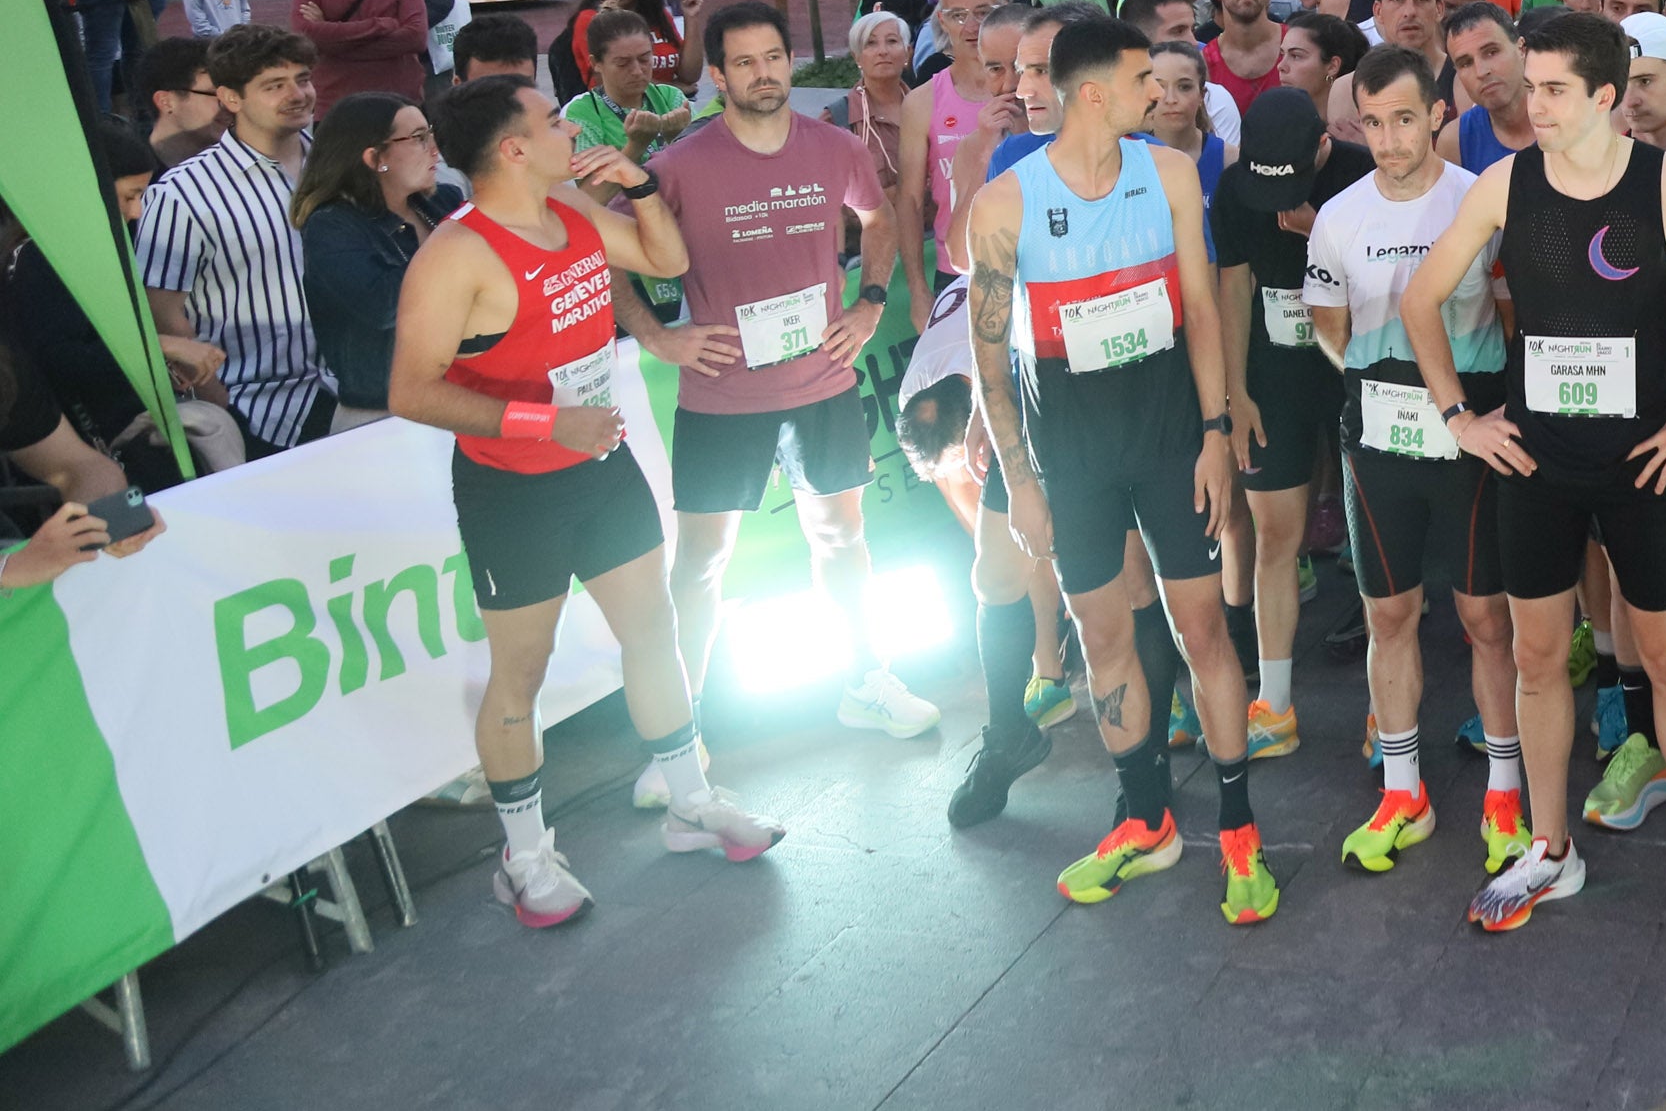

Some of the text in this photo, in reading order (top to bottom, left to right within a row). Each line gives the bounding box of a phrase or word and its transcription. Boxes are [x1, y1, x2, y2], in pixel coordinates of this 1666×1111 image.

[1250, 161, 1294, 177] HOKA
[725, 194, 826, 216] media maratón
[725, 214, 752, 222] Bidasoa
[742, 226, 773, 237] LOMEÑA
[740, 305, 756, 319] 10K
[1064, 305, 1083, 319] 10K
[1283, 308, 1305, 318] DANEL
[783, 315, 801, 326] IKER
[780, 326, 808, 351] 371
[1100, 327, 1148, 360] 1534
[1529, 340, 1544, 354] 10K
[1624, 346, 1629, 358] 1
[1551, 364, 1606, 376] GARASA MHN
[1559, 382, 1598, 405] 609
[1397, 407, 1418, 421] IÑAKI
[1390, 424, 1424, 448] 834
